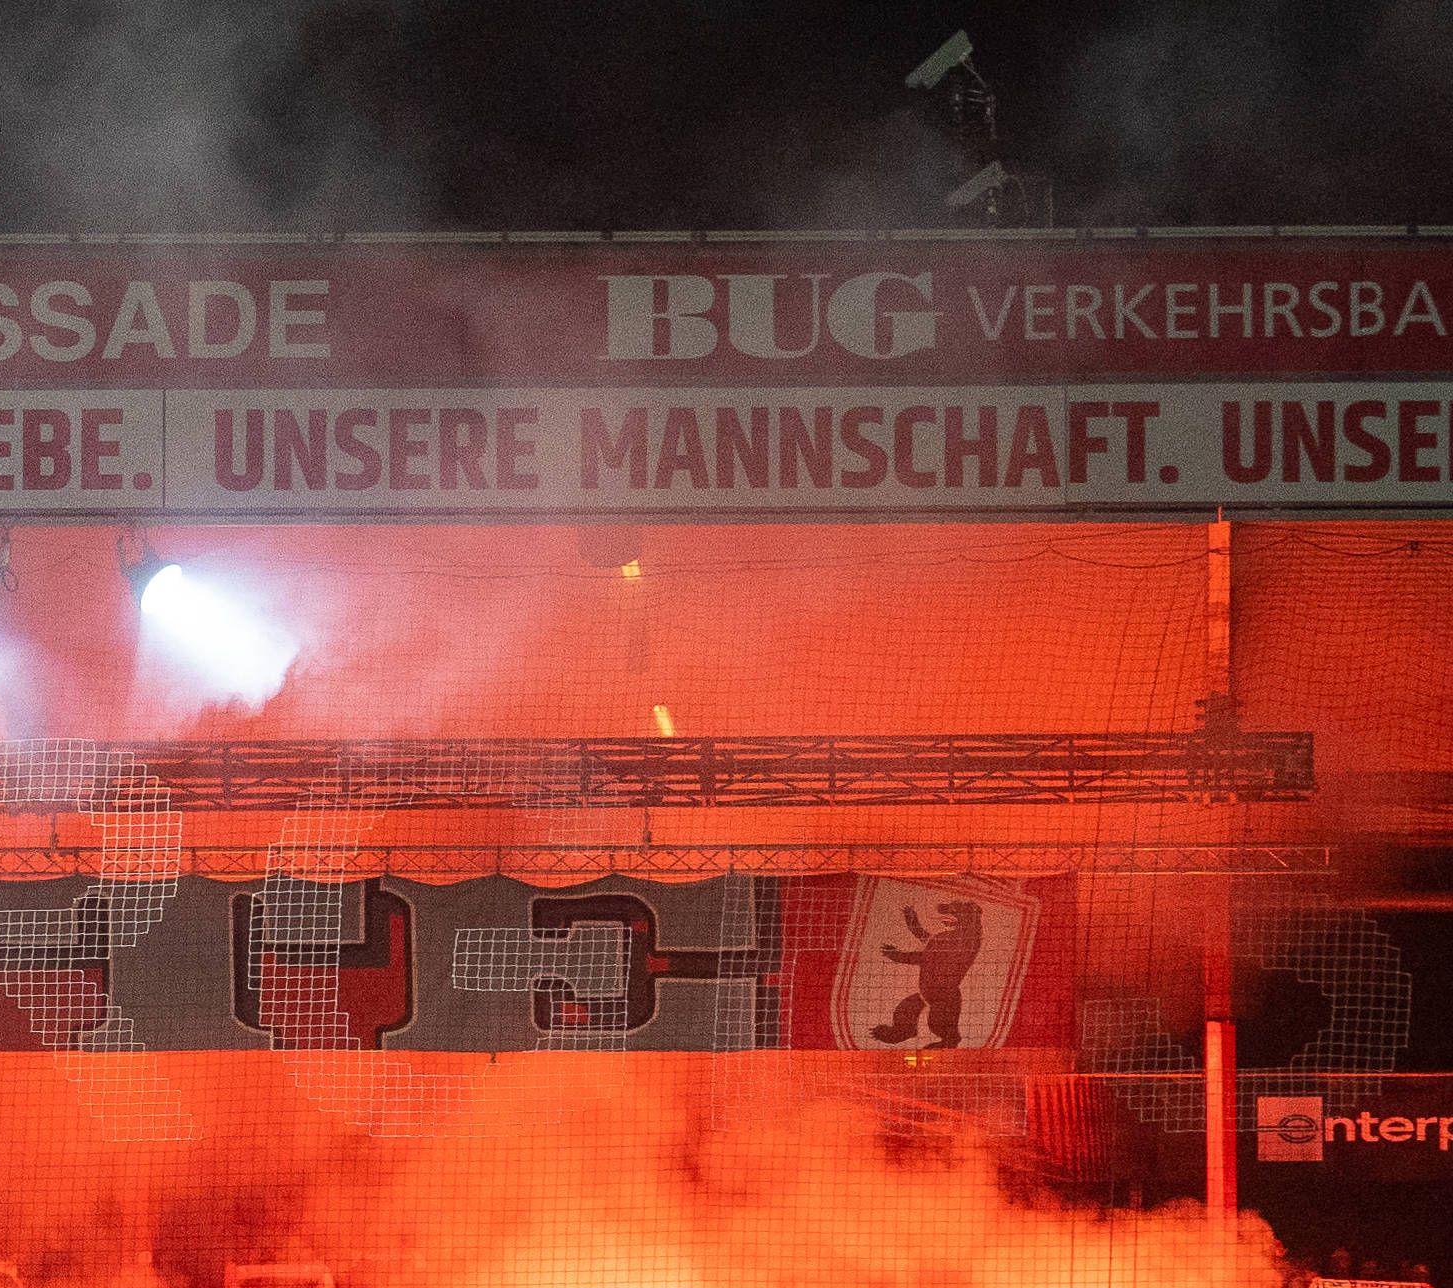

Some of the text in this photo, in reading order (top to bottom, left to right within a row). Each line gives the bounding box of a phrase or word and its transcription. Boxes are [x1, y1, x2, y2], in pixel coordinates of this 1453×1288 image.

[597, 271, 1447, 361] BUG VERKEHRSBA
[213, 400, 1179, 492] UNSERE MANNSCHAFT.
[1221, 400, 1453, 484] UNSE
